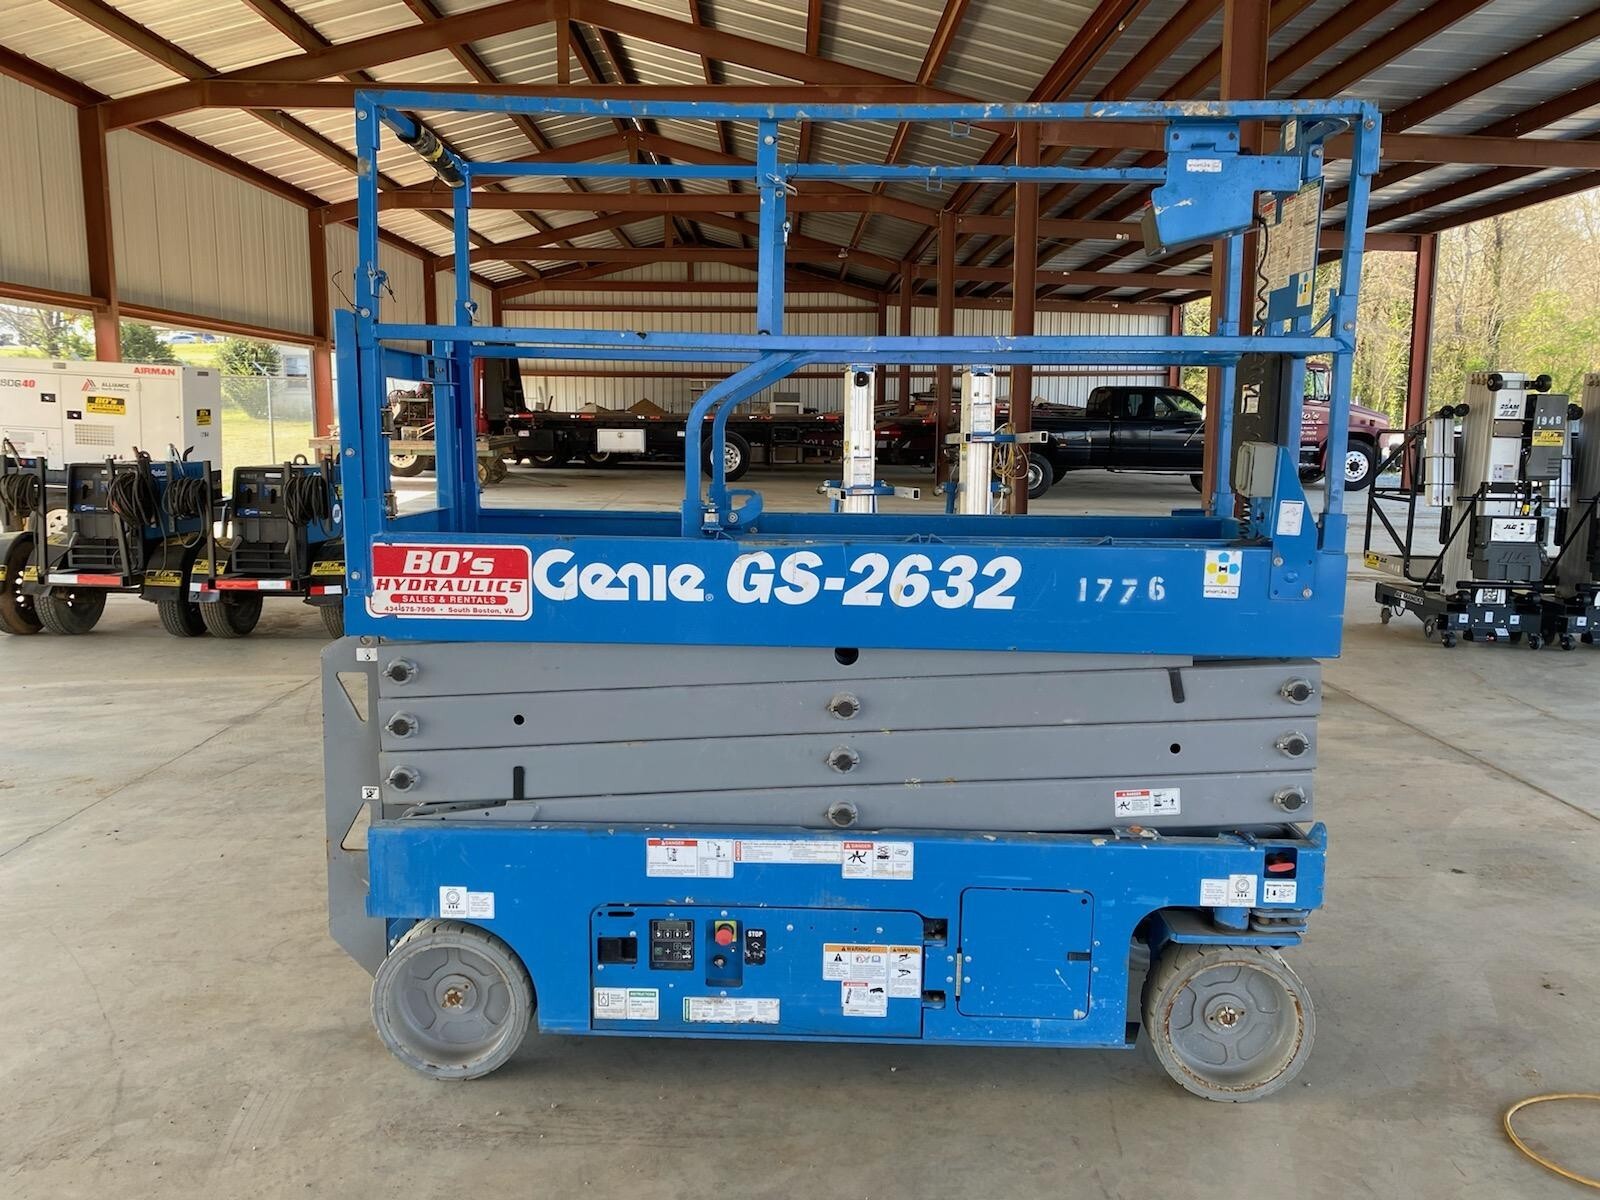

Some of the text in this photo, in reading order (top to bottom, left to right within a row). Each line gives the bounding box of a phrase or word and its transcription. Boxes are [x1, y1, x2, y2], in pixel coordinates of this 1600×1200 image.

[133, 367, 176, 376] AIRMAN
[402, 550, 495, 576] BO's
[533, 548, 705, 602] Genie
[726, 551, 1023, 610] GS-2632
[376, 578, 523, 593] HYDRAULICS
[1078, 576, 1165, 604] 1776
[402, 594, 497, 604] SALES & RENTALS
[747, 930, 763, 938] STOP
